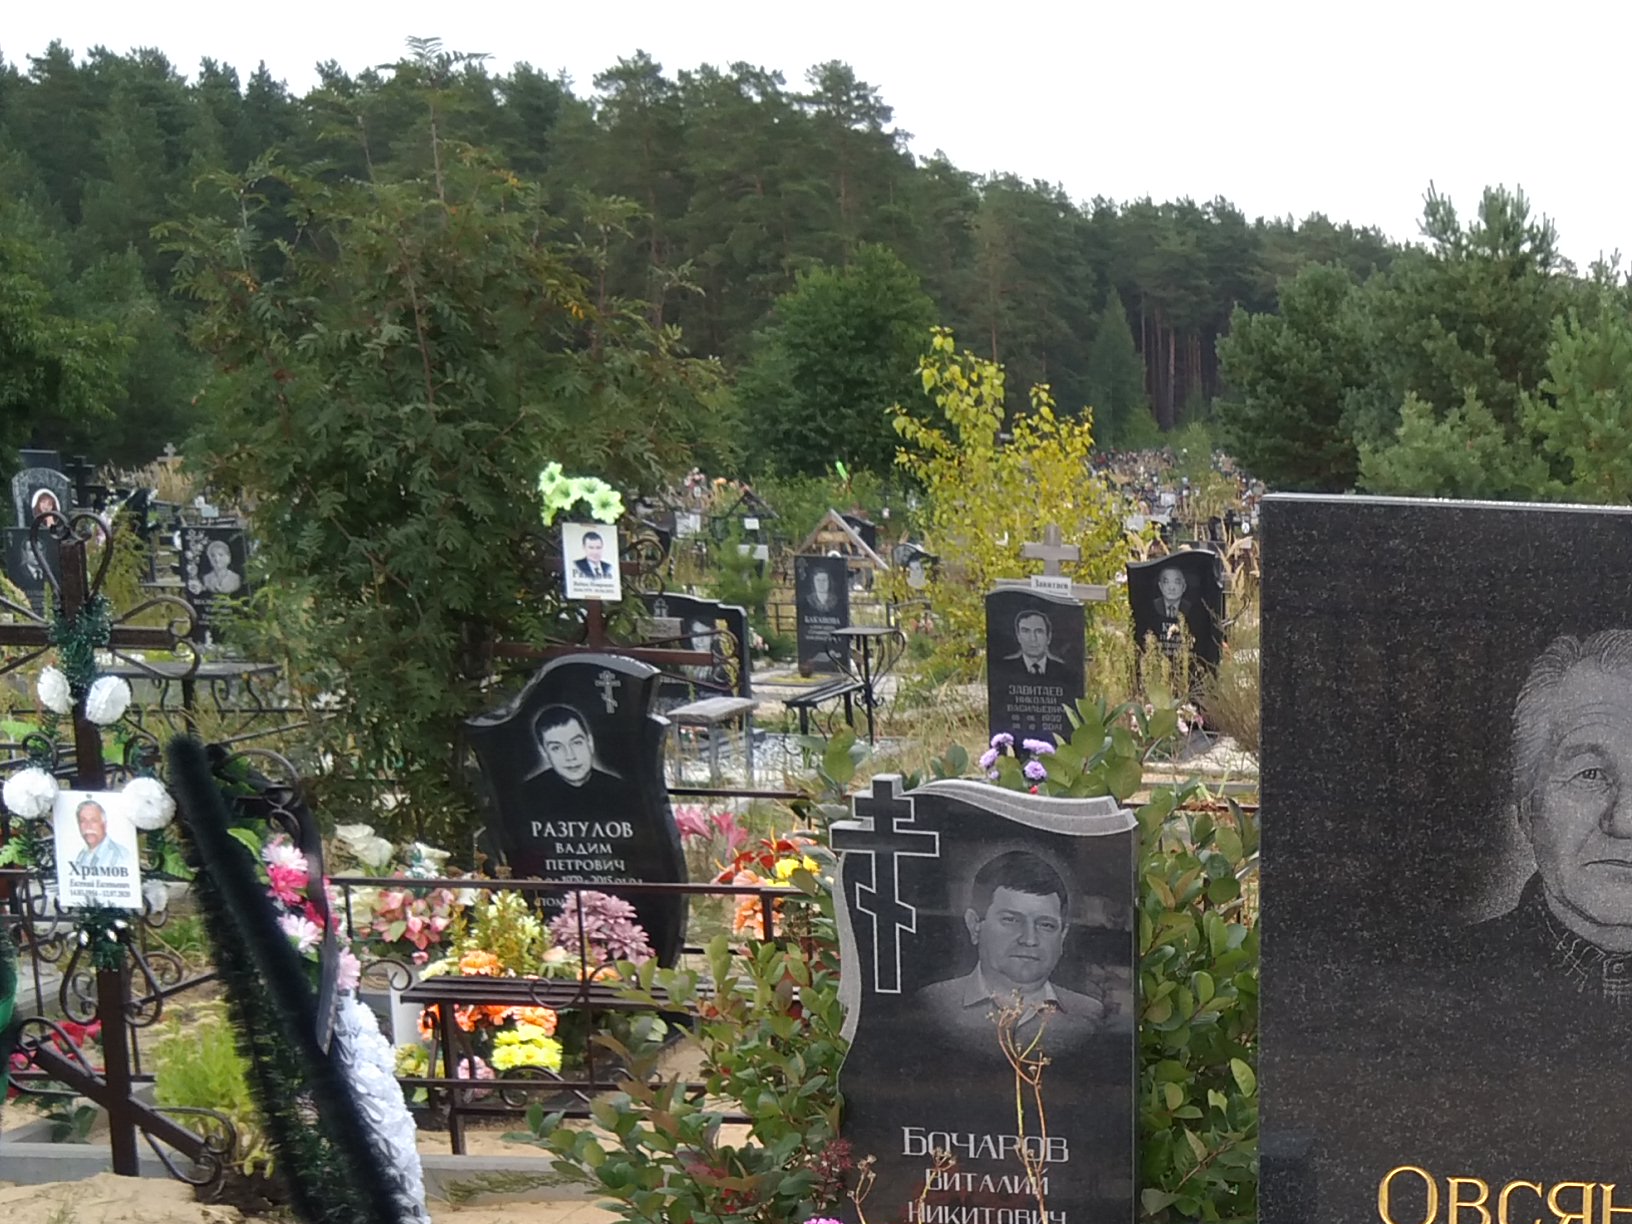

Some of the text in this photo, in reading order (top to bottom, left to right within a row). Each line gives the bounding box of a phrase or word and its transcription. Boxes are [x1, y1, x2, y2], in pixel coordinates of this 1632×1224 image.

[1008, 684, 1064, 697] ЗАВИТАЕВ
[530, 820, 634, 839] РАЗГУЛОВ
[555, 842, 613, 856] ВАДИМ
[68, 861, 130, 880] Храмов
[545, 859, 626, 872] ПЕТРОВИЧ
[901, 1126, 1069, 1163] БОЧАРОВ
[924, 1167, 1050, 1196] ВИТАЛИЙ
